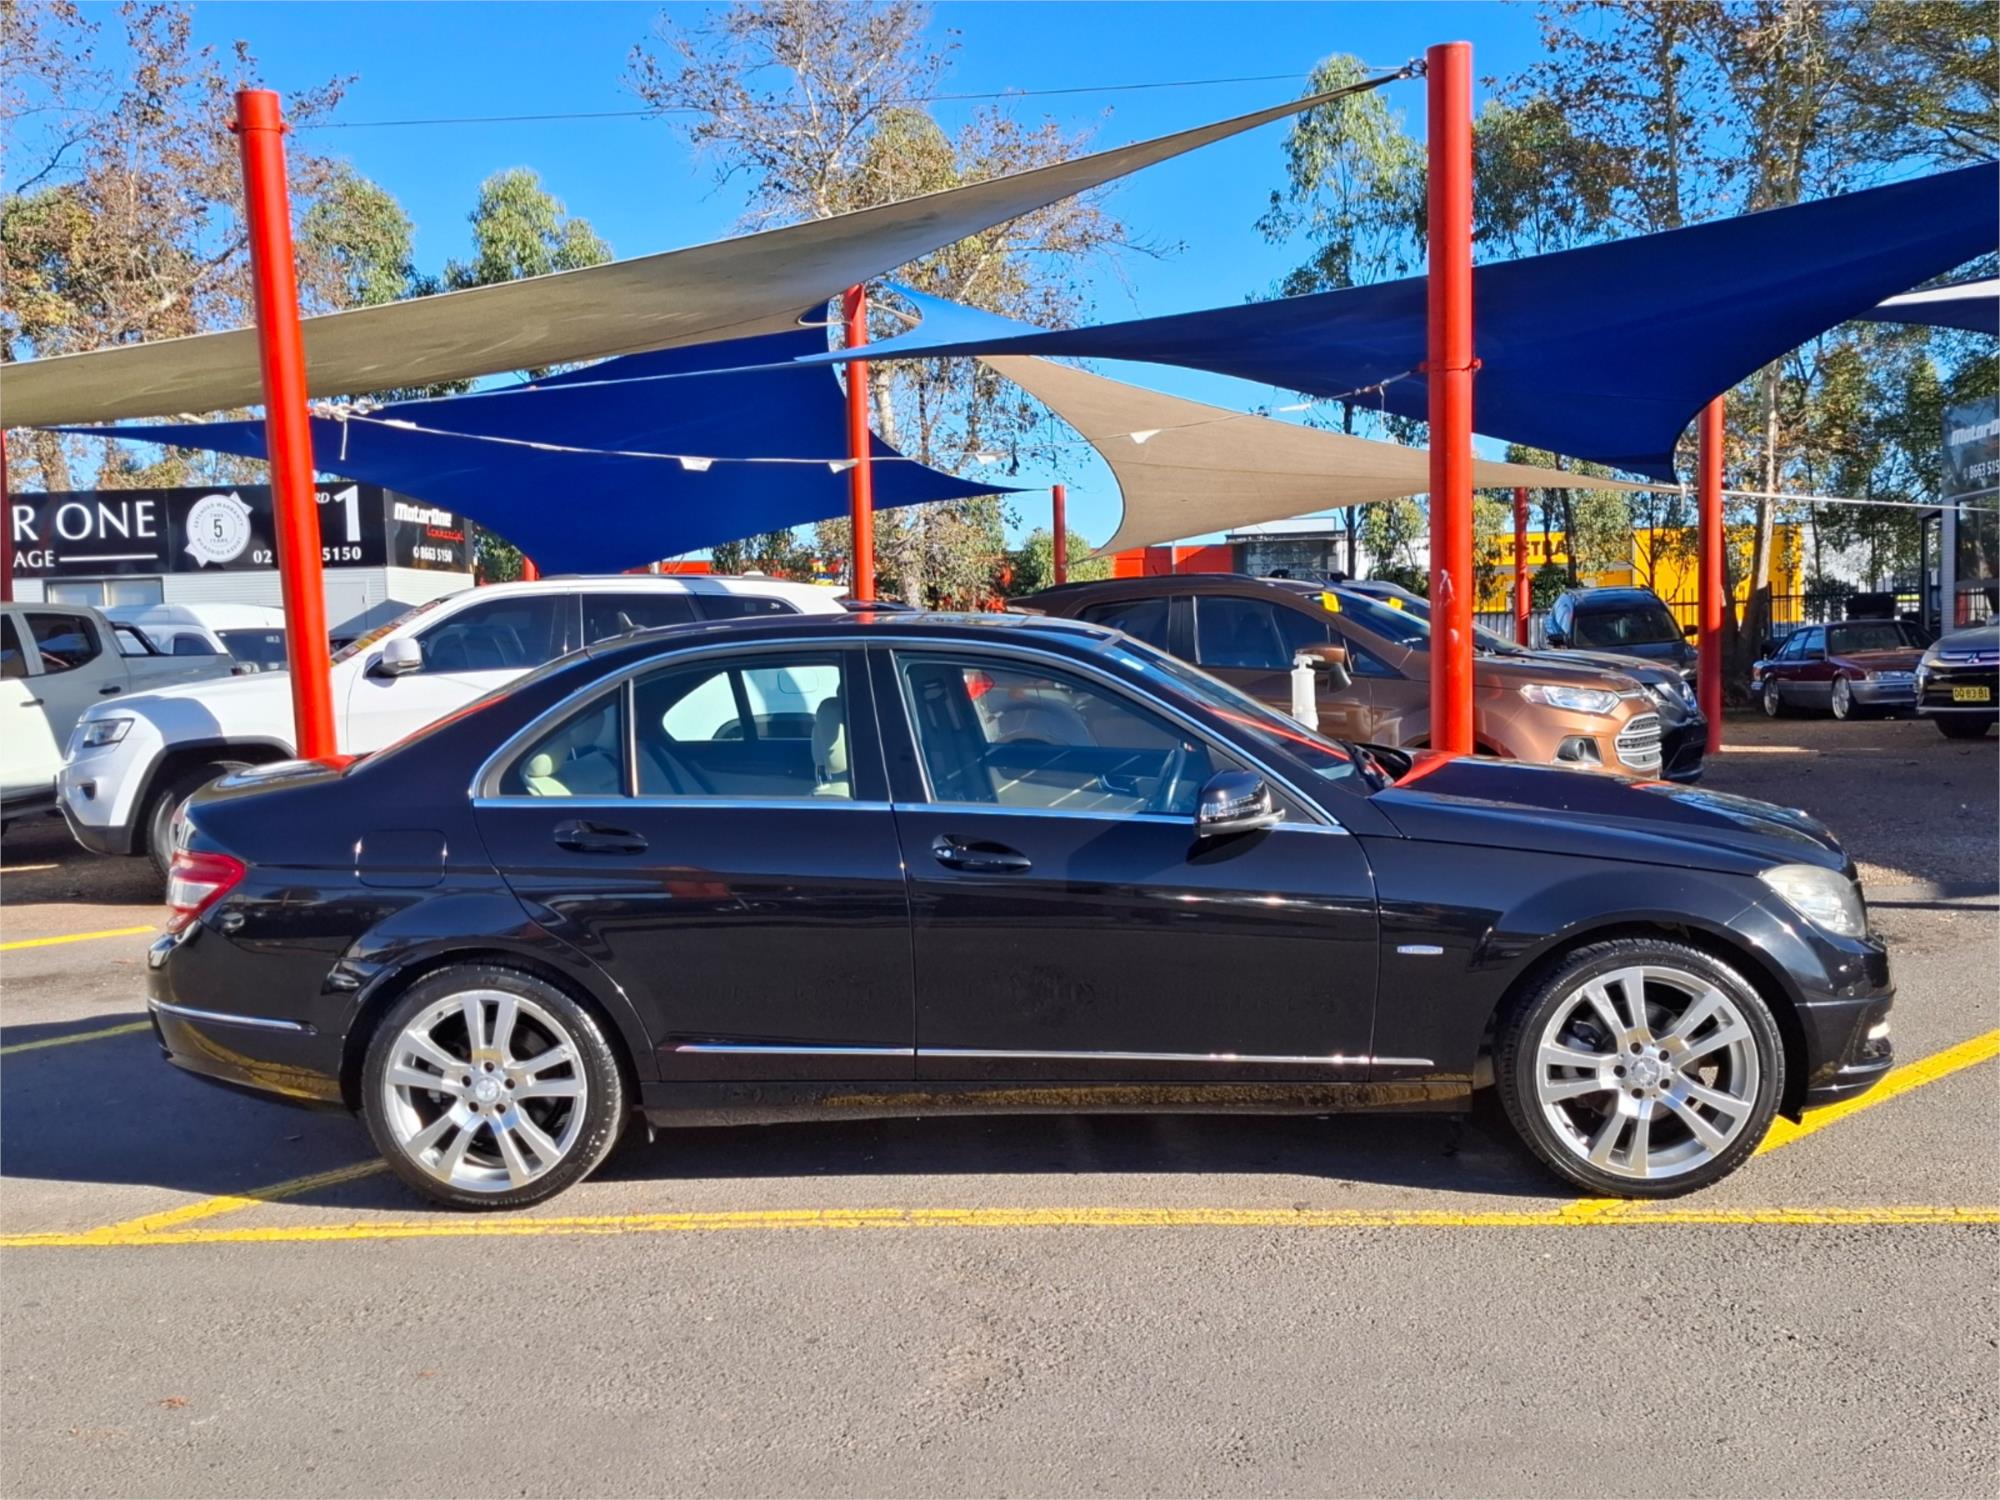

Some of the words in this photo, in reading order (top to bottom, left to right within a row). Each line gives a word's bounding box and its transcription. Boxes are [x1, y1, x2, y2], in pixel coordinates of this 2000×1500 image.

[55, 500, 158, 541] ONE
[213, 518, 223, 538] 5
[333, 484, 361, 542] 1
[252, 549, 273, 564] 02
[322, 546, 363, 561] 5150
